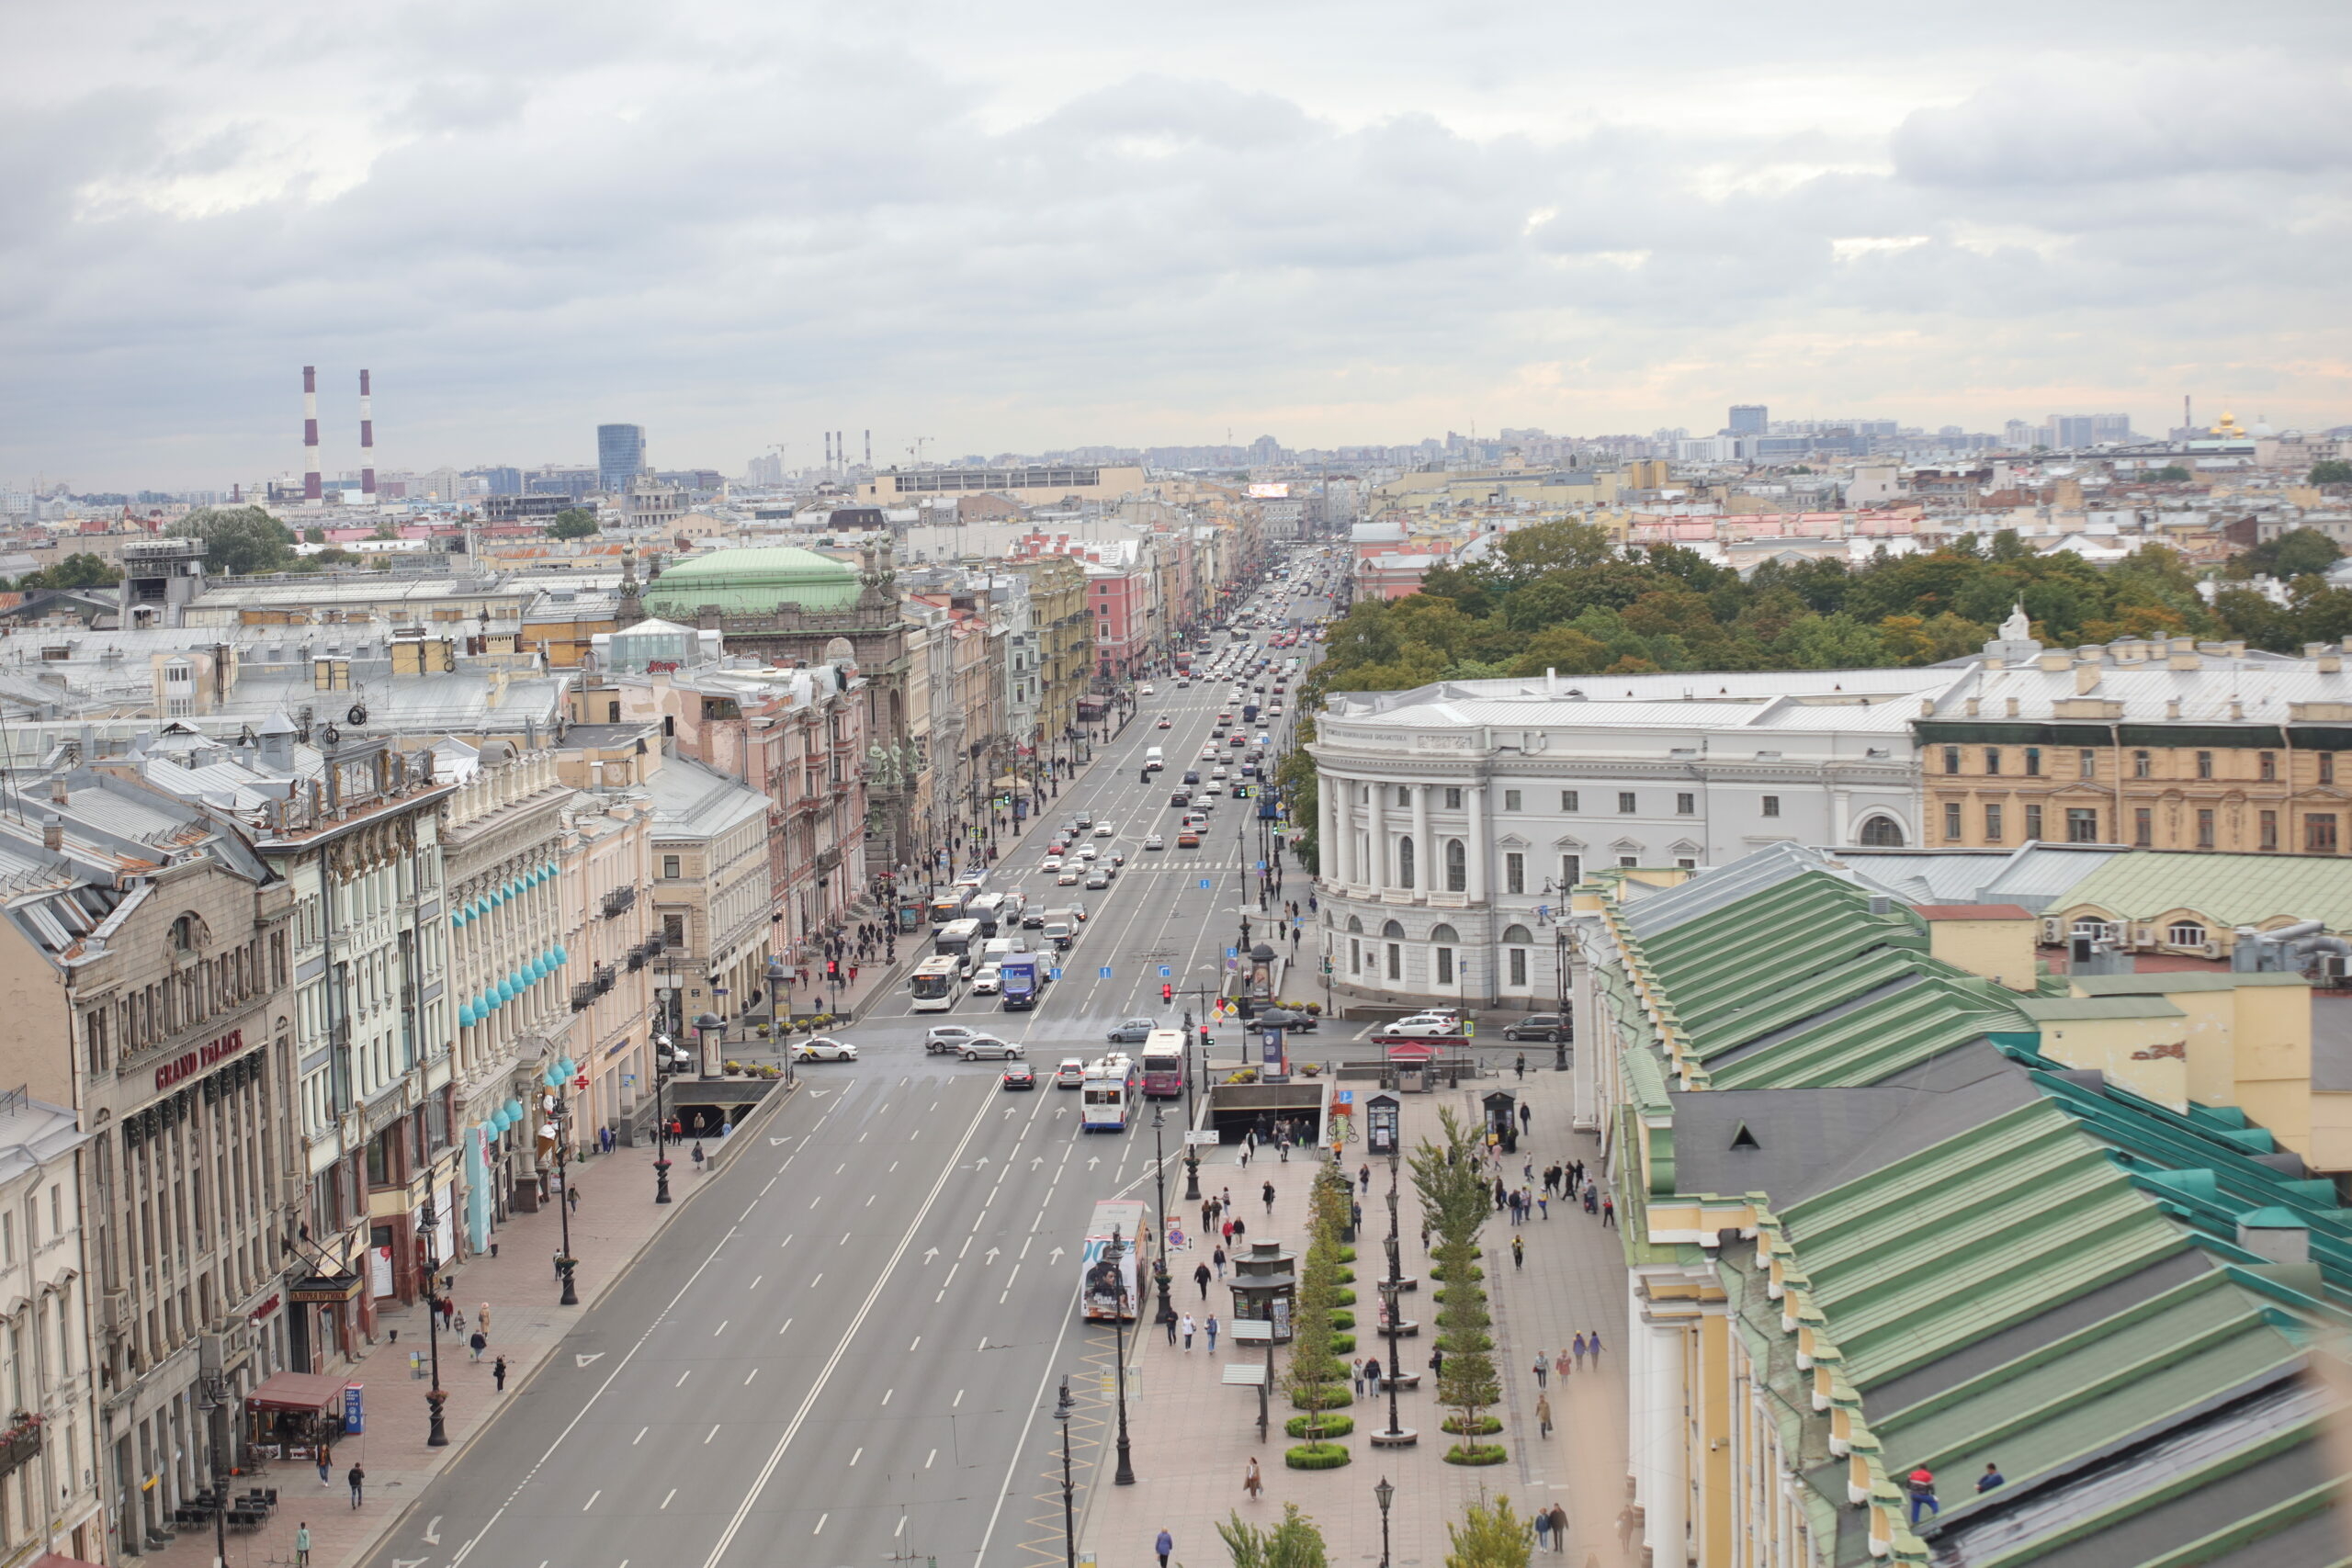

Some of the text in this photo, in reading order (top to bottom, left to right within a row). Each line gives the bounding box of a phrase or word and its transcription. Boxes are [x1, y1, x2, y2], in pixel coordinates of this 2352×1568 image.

[155, 1029, 243, 1092] GRAND PALACE
[290, 1292, 347, 1301] ГАЛЕРЕЯ БУТИКОВ
